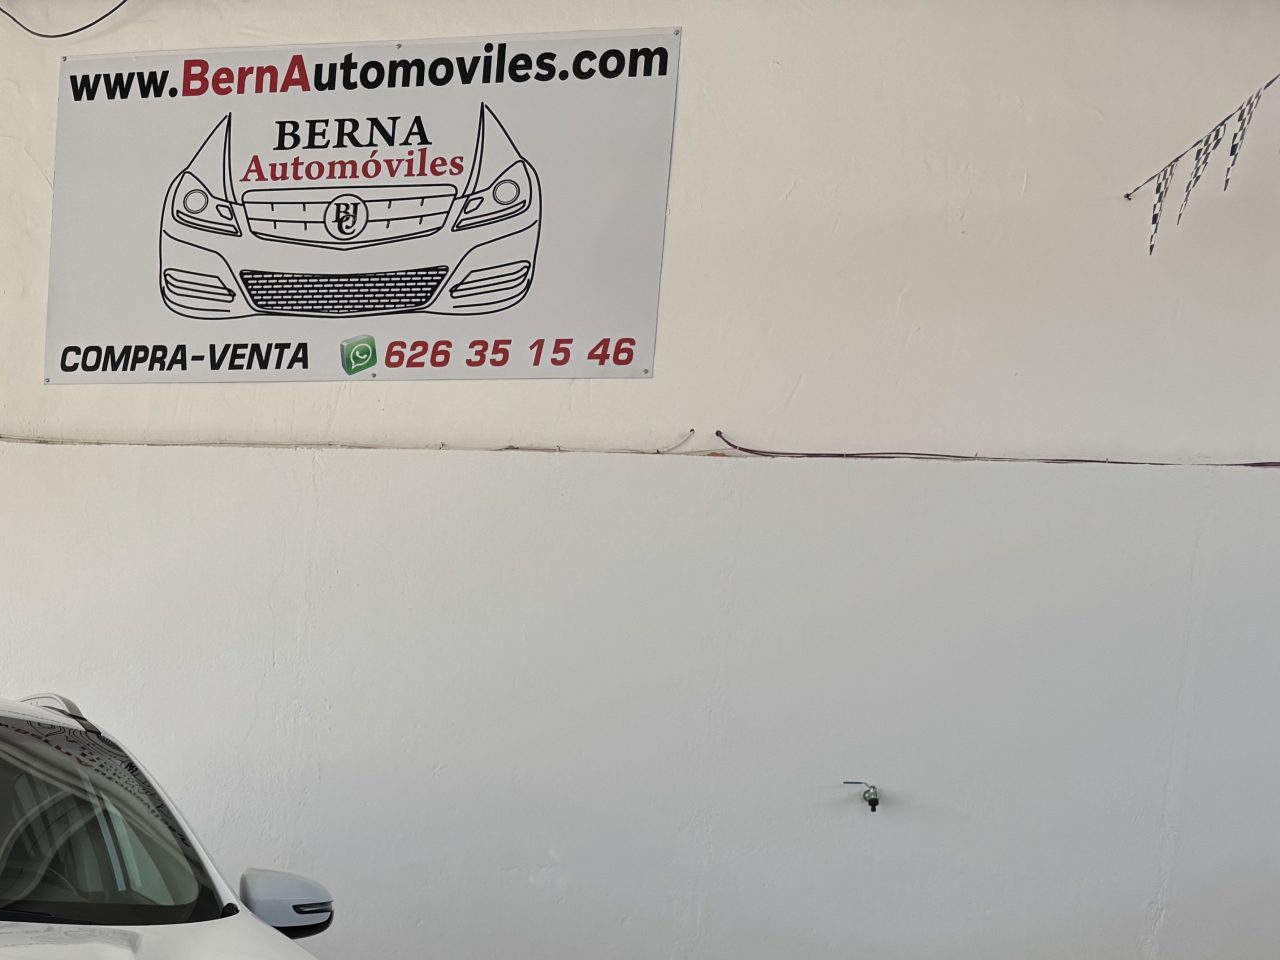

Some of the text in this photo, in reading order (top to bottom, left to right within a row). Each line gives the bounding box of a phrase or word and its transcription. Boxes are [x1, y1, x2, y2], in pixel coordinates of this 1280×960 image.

[70, 43, 669, 103] www.BernAutomoviles.com
[273, 115, 432, 151] BERNA
[240, 147, 465, 183] Automóviles
[61, 343, 309, 372] COMPRA-VENTA
[384, 338, 635, 368] 626 35 15 46
